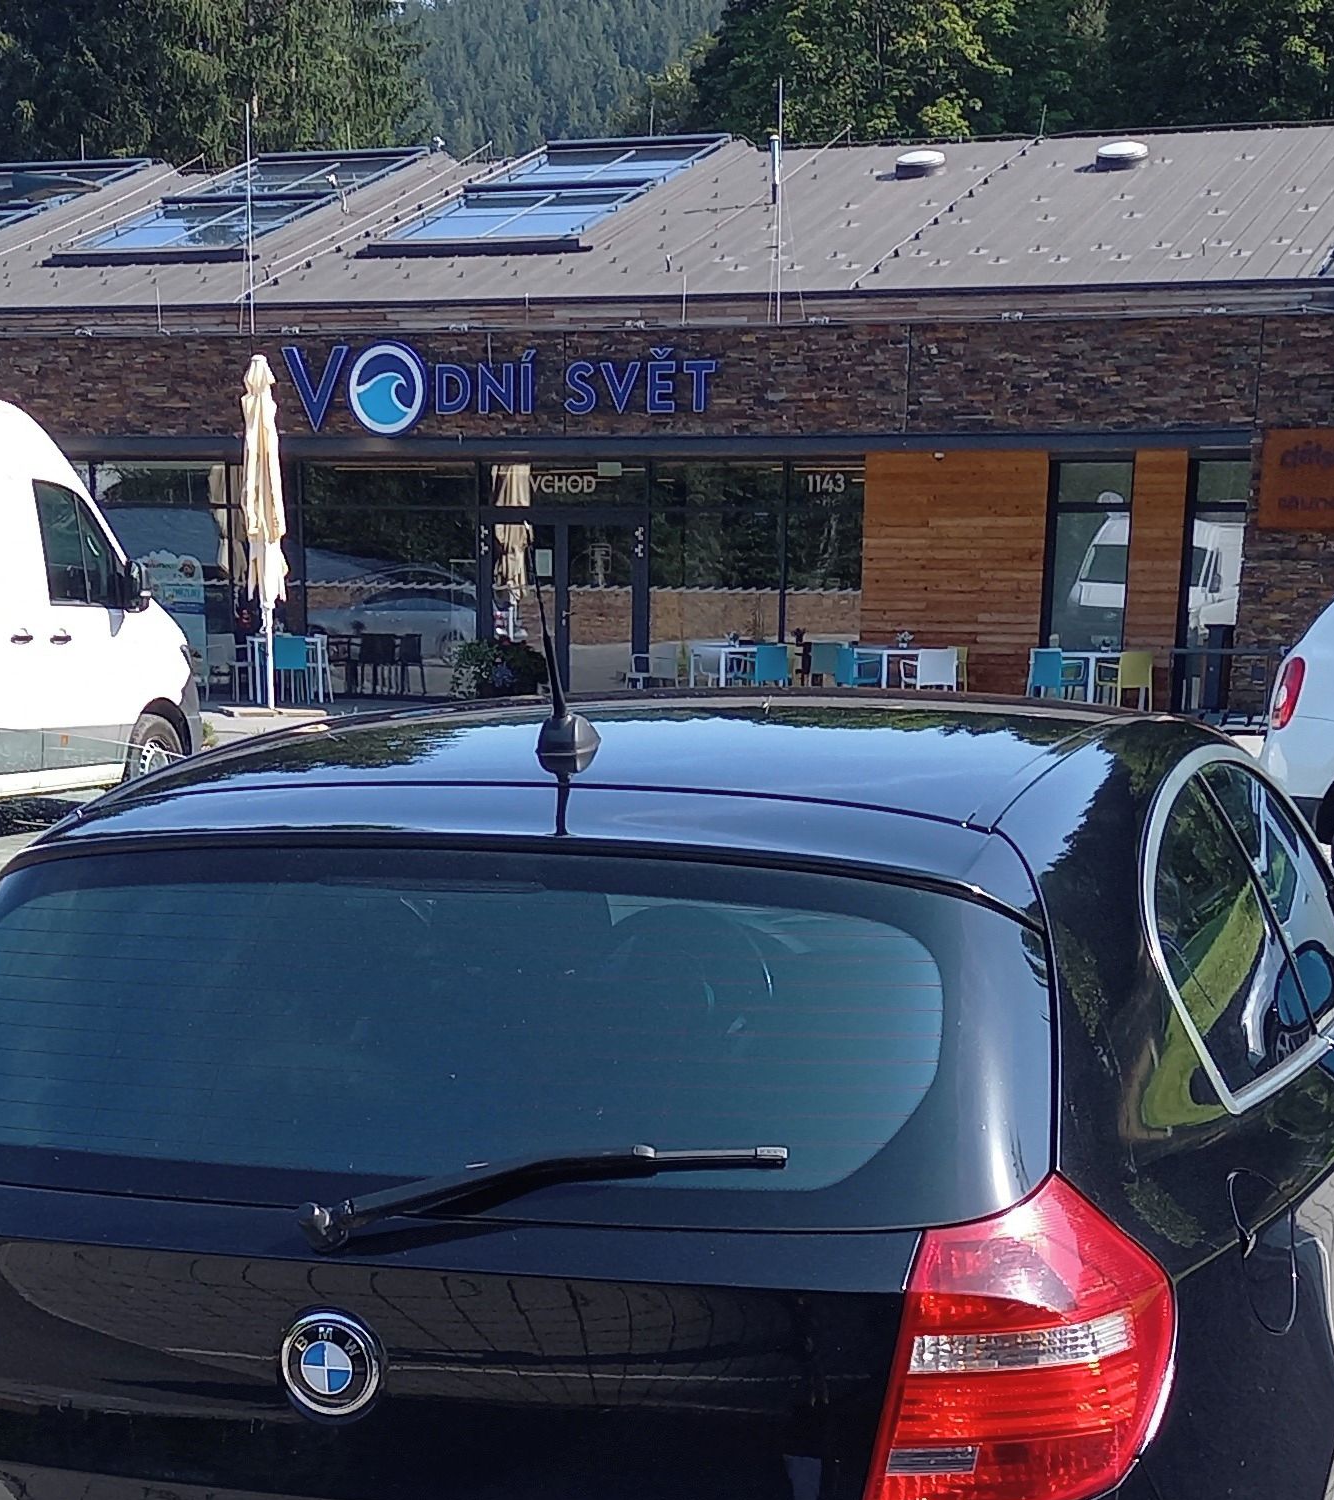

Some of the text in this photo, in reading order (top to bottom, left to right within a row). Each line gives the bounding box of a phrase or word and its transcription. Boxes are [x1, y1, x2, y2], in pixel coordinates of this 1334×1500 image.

[564, 347, 716, 415] SVĚT
[529, 474, 596, 494] VCHOD
[807, 472, 845, 493] 1143
[294, 1326, 361, 1357] BMW
